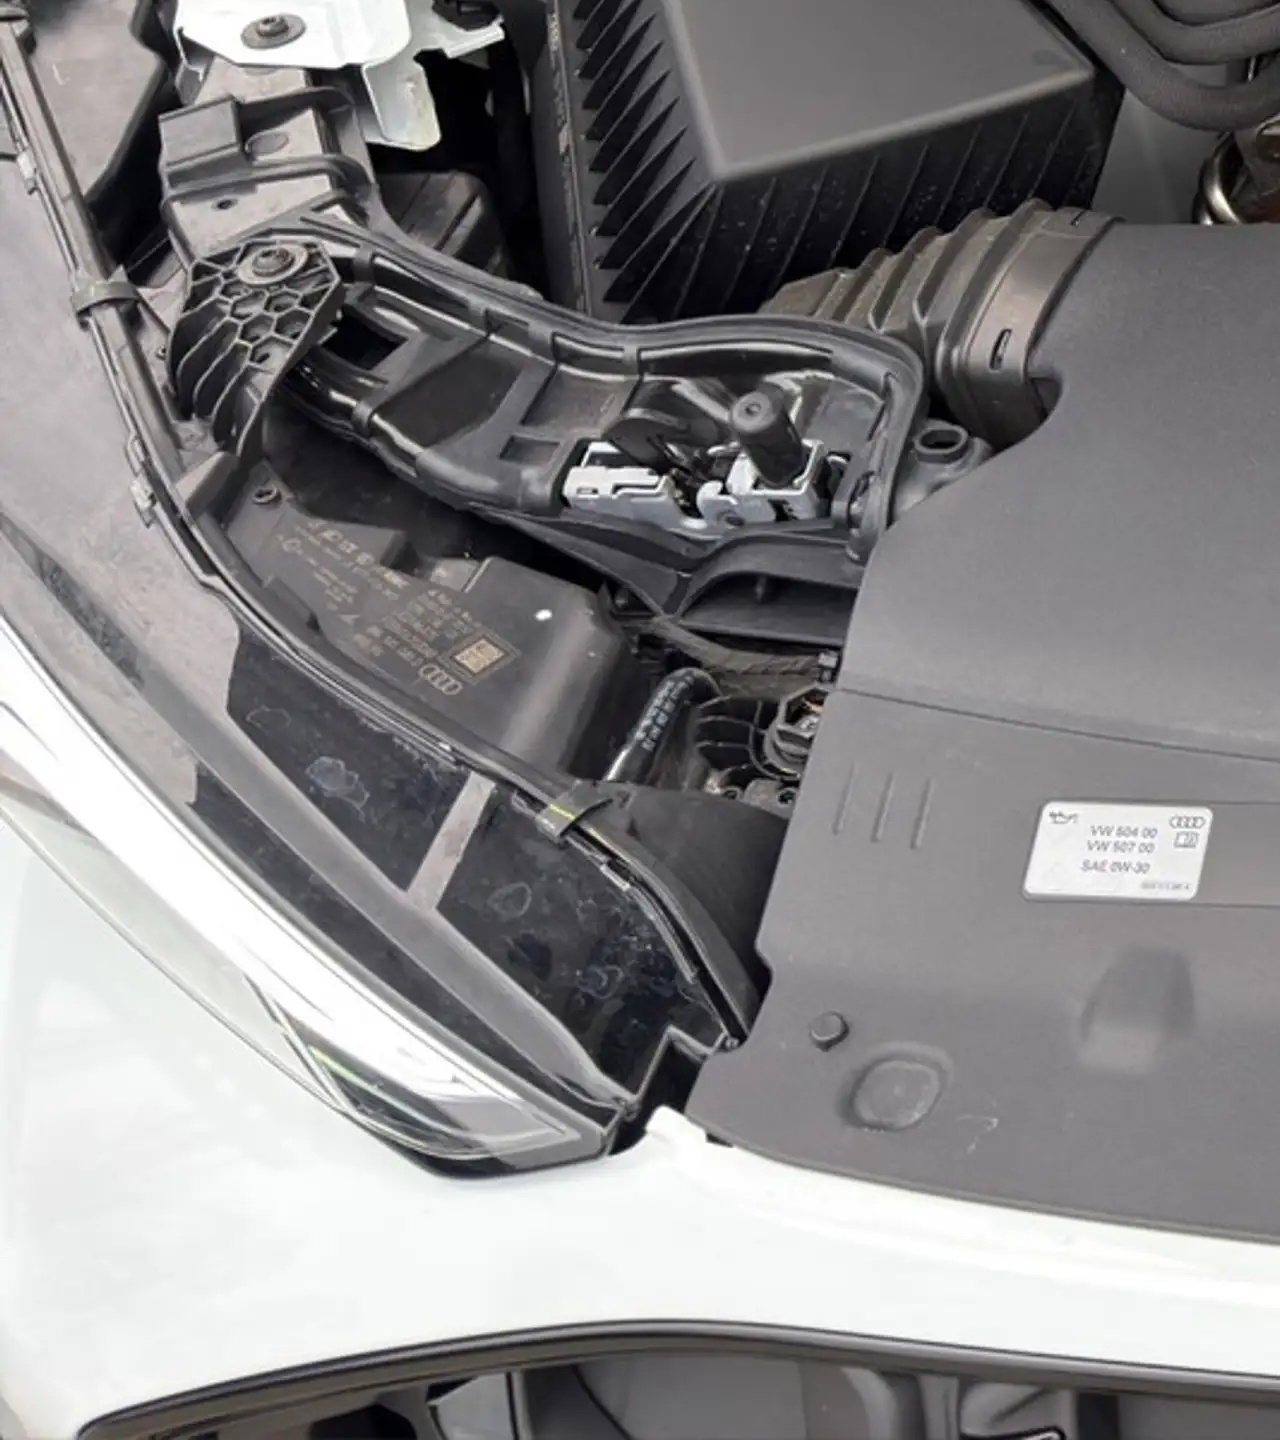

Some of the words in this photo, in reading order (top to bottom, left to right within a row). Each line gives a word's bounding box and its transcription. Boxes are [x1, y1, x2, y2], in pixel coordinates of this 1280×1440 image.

[1090, 825, 1114, 836] VW
[1116, 826, 1138, 837] 504
[1141, 827, 1158, 838] 00
[1087, 839, 1111, 851] VW
[1138, 842, 1155, 853] 00
[1080, 859, 1108, 872] SAE
